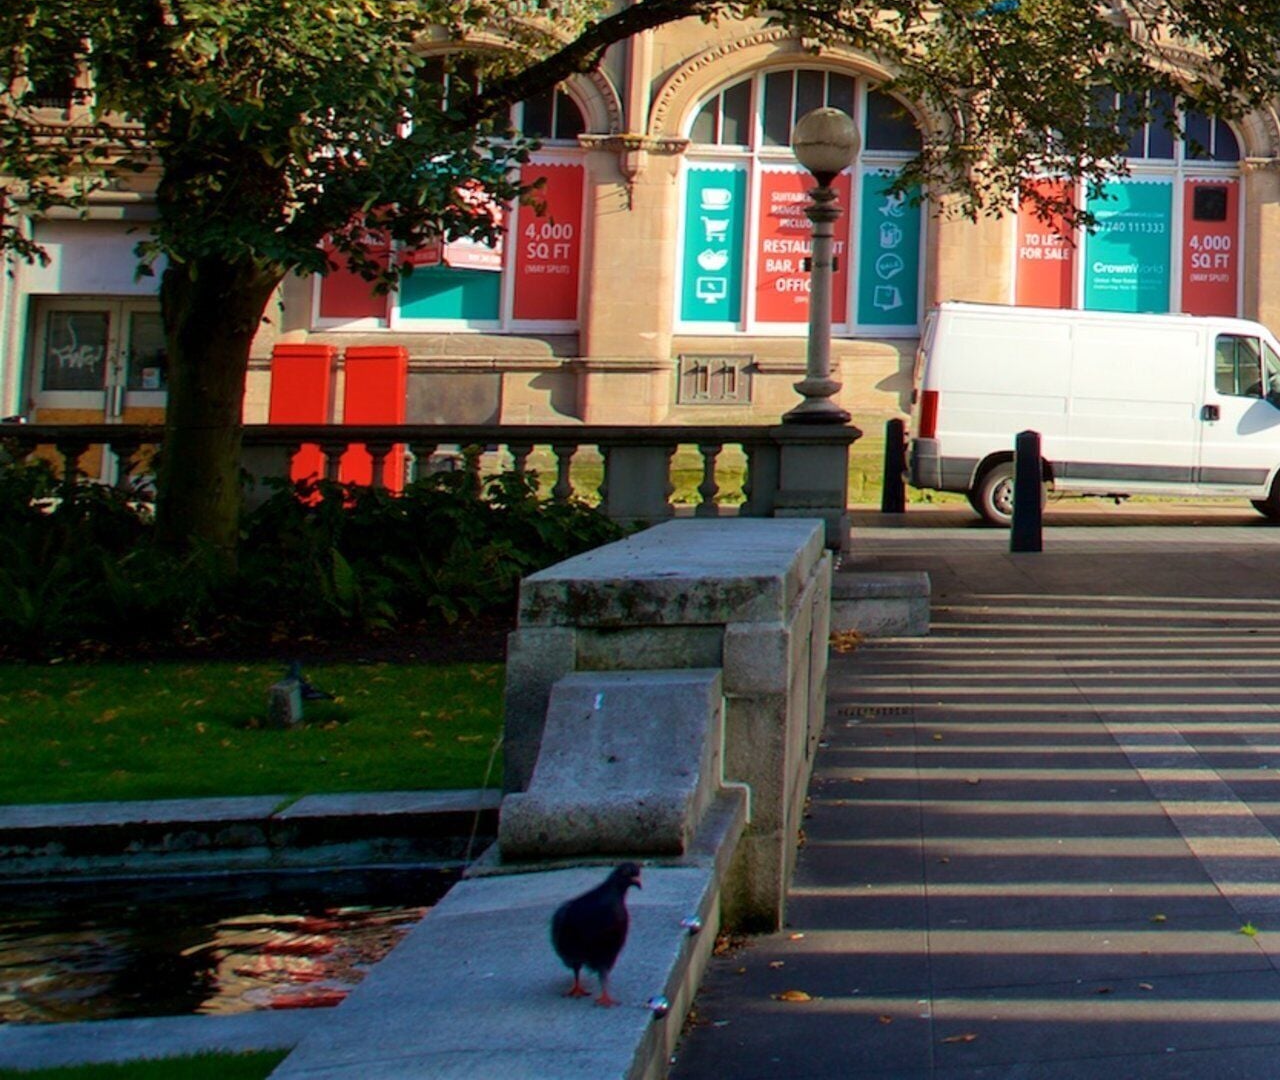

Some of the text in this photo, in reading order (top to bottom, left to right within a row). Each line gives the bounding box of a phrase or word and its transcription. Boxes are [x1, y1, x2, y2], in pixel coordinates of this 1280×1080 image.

[525, 223, 573, 241] 4,000
[1024, 233, 1040, 246] TO
[526, 242, 570, 259] SQ FT
[763, 239, 844, 254] RESTAUNT
[1189, 235, 1231, 252] 4,000
[1020, 247, 1069, 260] FOR SALE
[1191, 252, 1230, 269] SQ FT
[776, 278, 811, 292] OFFIC
